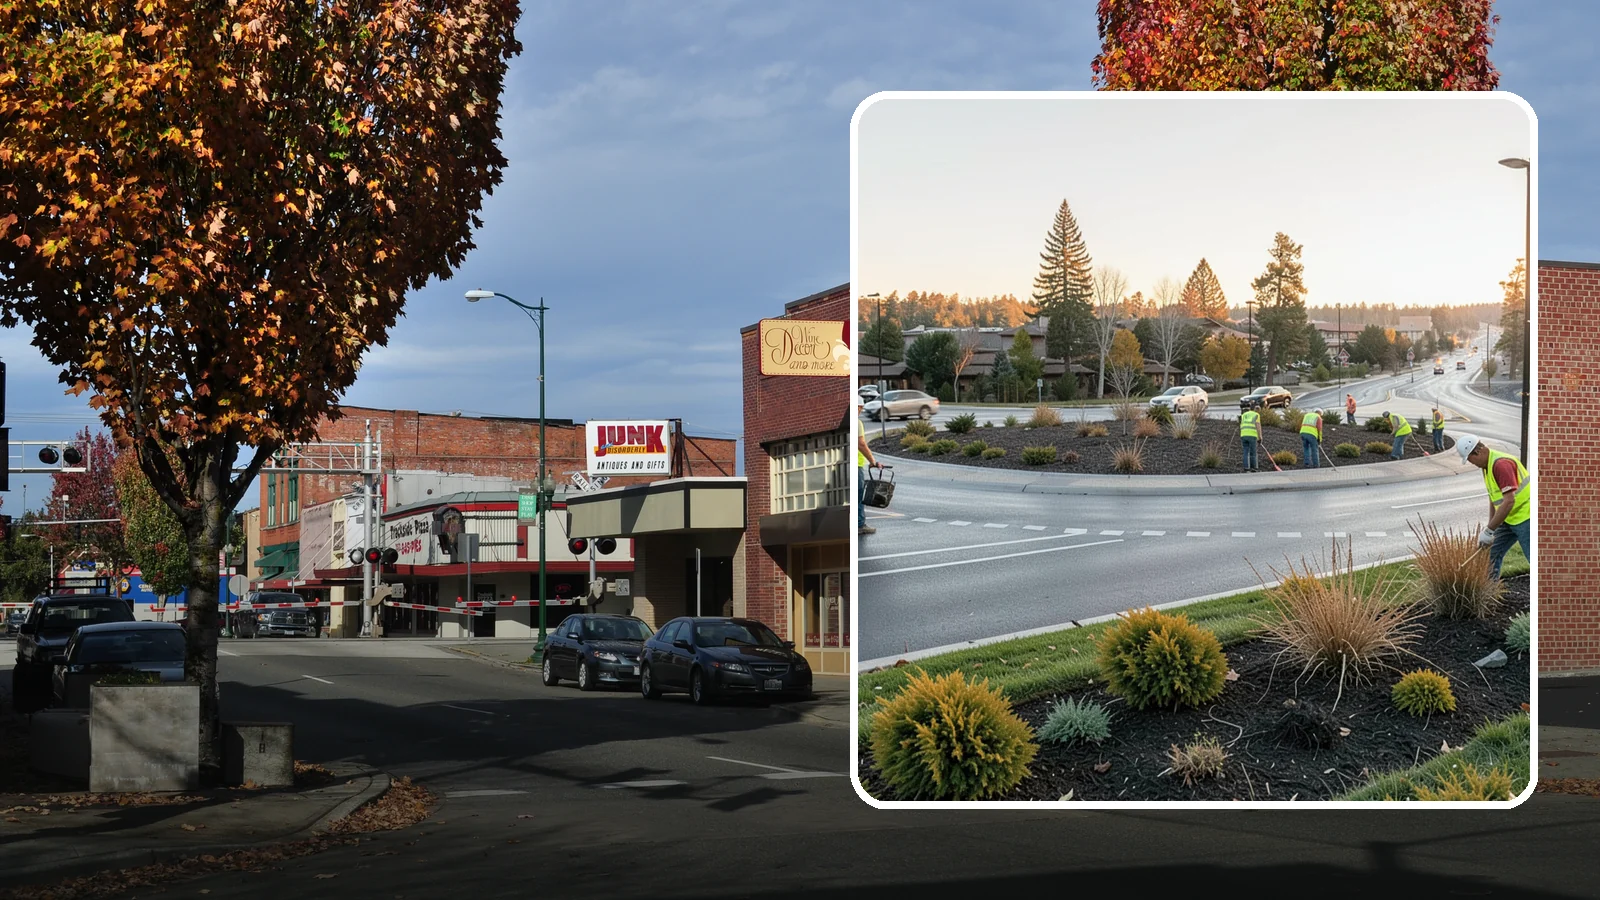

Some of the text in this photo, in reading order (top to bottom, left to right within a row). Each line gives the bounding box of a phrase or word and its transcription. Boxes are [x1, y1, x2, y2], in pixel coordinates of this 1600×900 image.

[596, 426, 666, 457] JUNK
[597, 460, 665, 470] ANTIQUES AND GIFTS
[414, 520, 430, 535] Pizza
